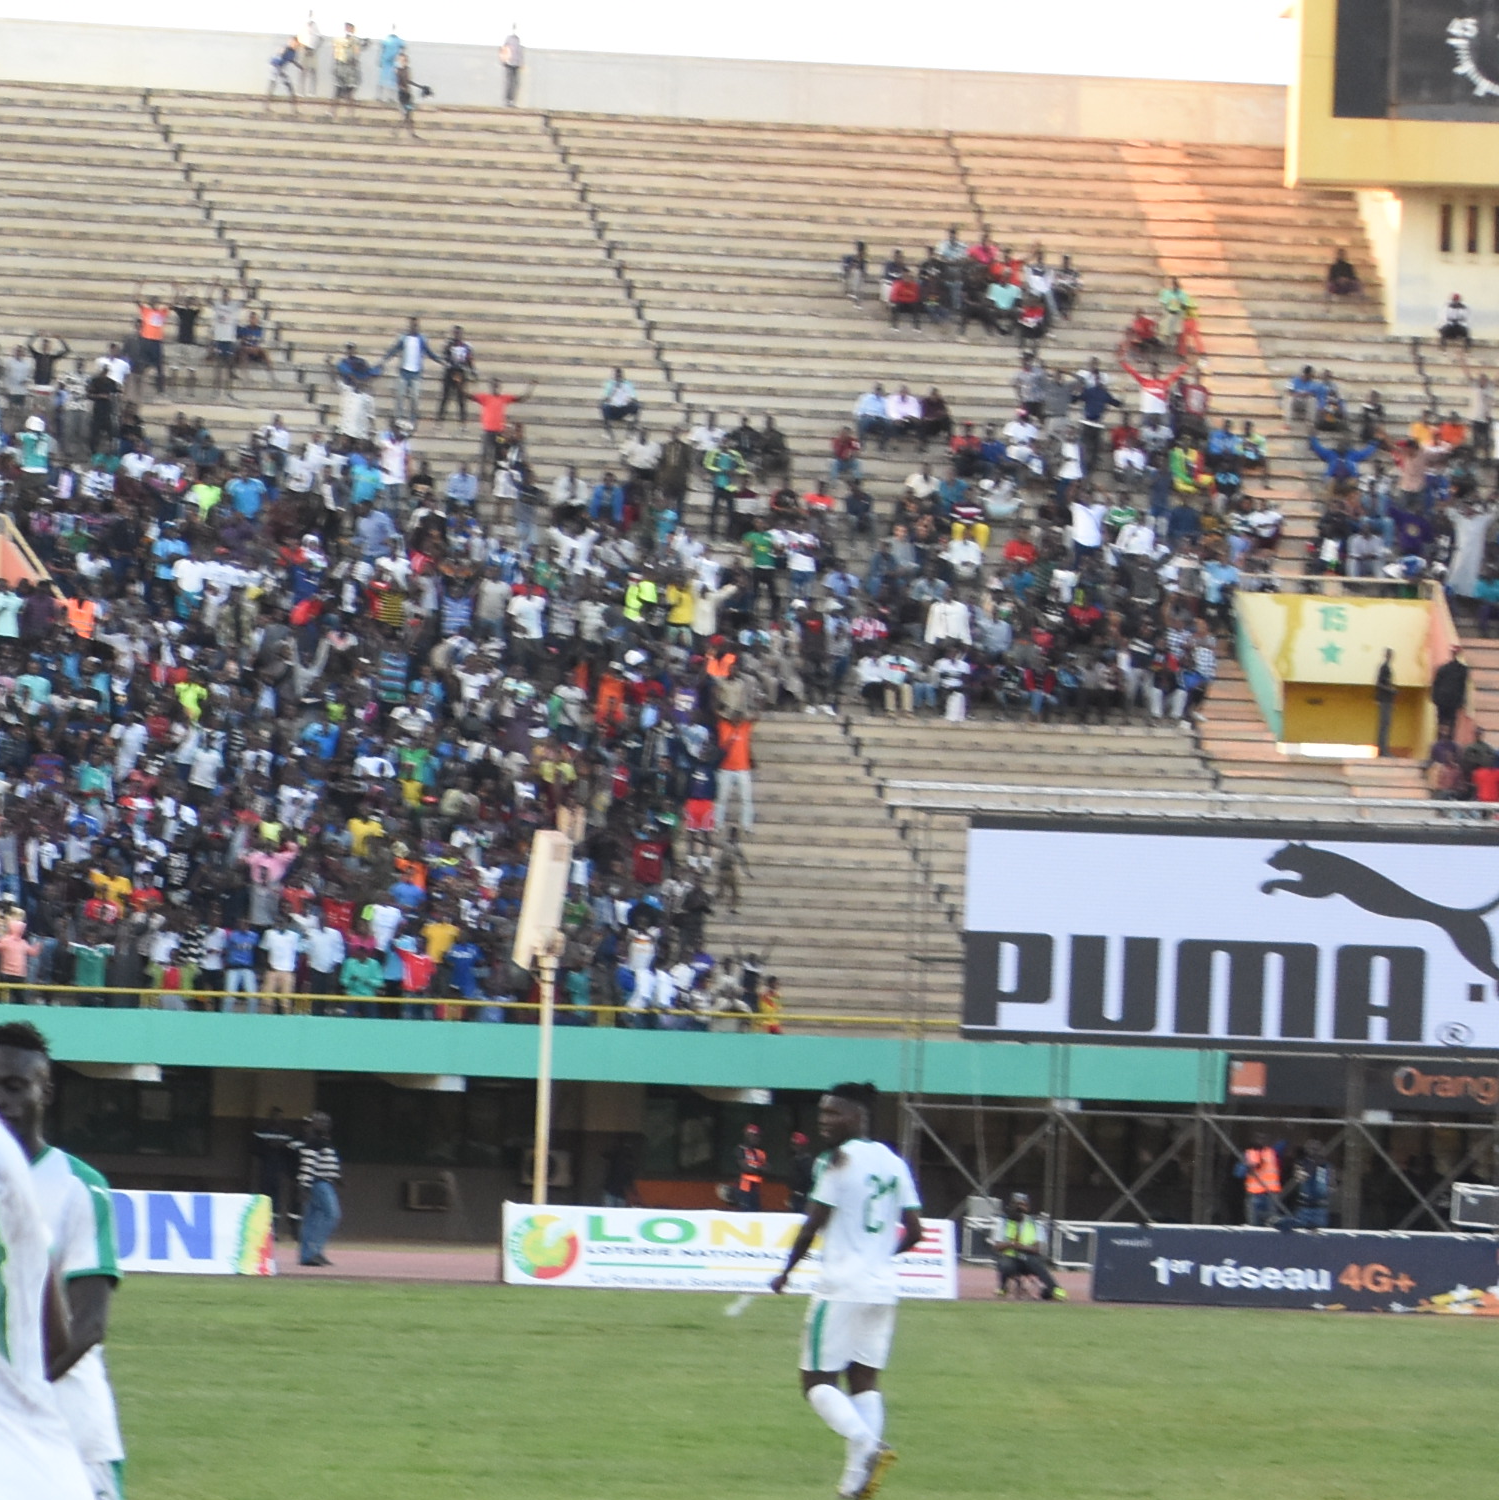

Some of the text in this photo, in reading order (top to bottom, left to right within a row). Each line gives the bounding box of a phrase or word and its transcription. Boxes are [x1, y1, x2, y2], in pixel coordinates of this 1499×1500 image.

[1317, 606, 1348, 632] 15
[964, 931, 1426, 1043] PUMA
[1199, 1257, 1332, 1292] réseau
[1338, 1262, 1417, 1294] 4G+
